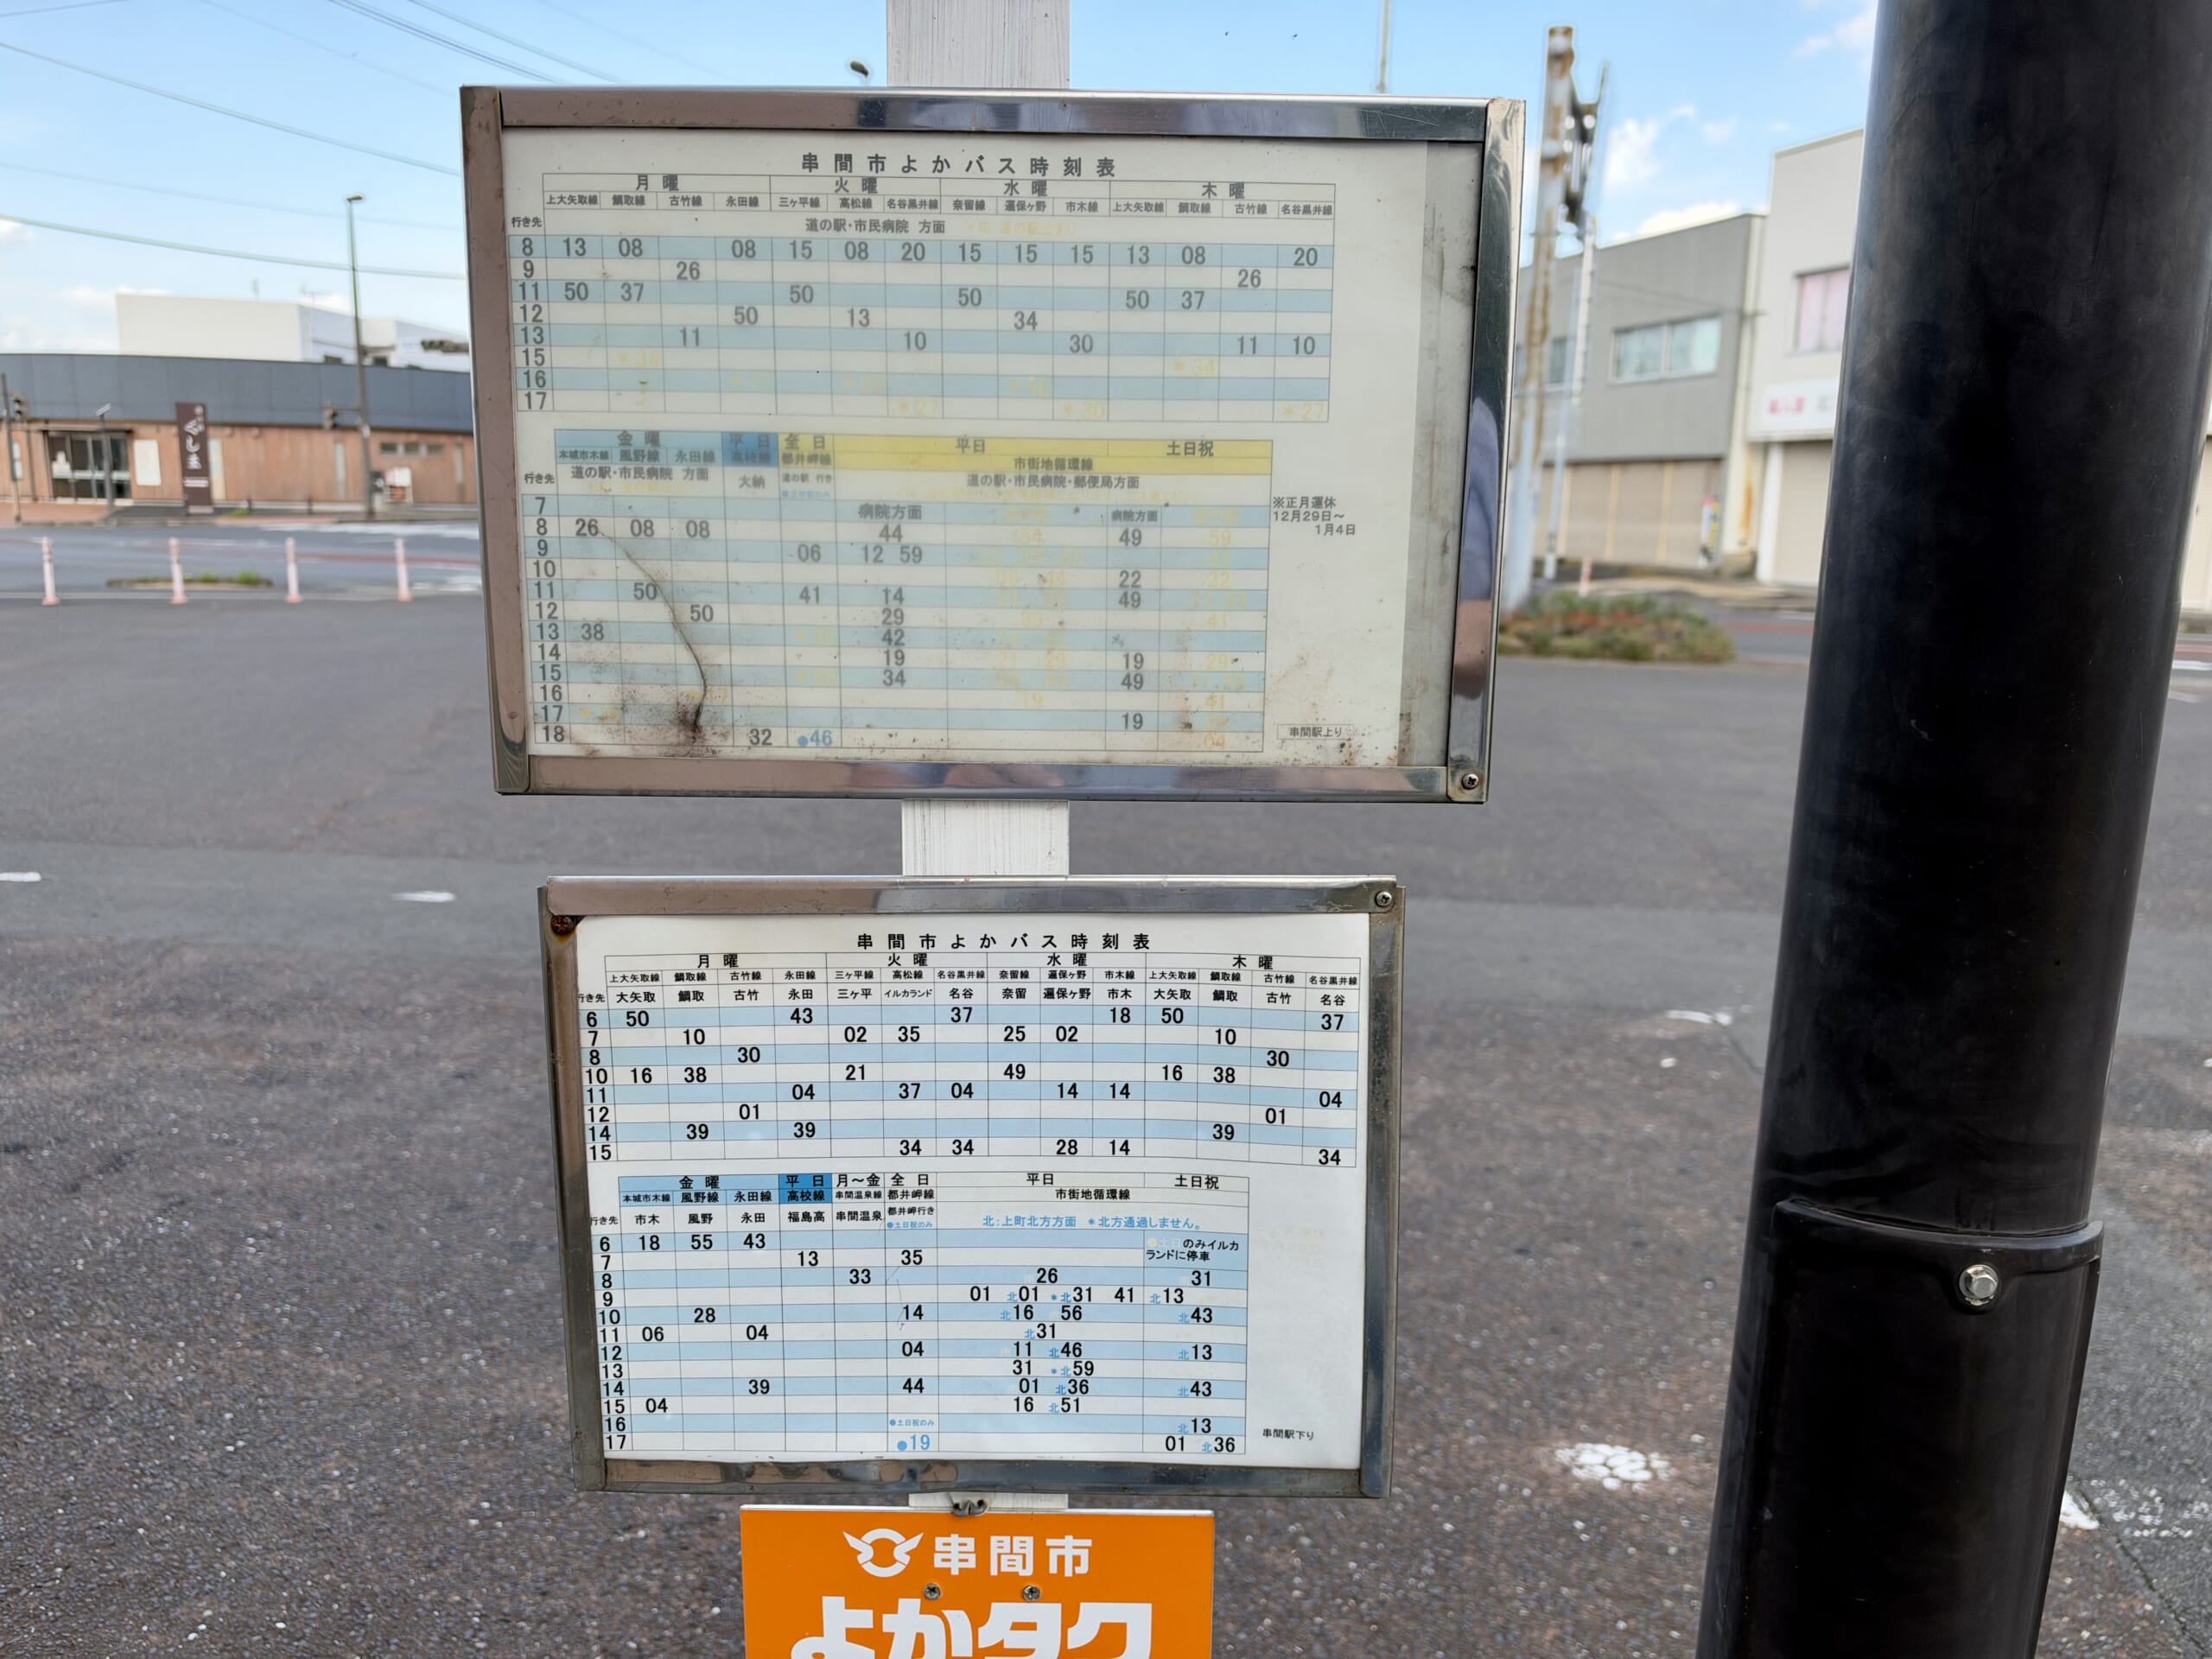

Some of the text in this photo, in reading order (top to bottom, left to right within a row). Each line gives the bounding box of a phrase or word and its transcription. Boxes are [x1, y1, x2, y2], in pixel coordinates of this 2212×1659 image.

[801, 151, 1115, 177] 串間市よかバス時刻表
[636, 175, 678, 192] 月曜
[835, 177, 878, 194] 火曜
[1002, 180, 1048, 197] 水曜
[1202, 182, 1245, 200] 木曜
[545, 194, 598, 207] 上大矢取線
[670, 195, 702, 207] 古竹線
[727, 196, 759, 207] 永田線
[779, 195, 821, 208] 三ヶ平線
[840, 195, 872, 209] 高松線
[953, 199, 985, 211] 奈留線
[1066, 201, 1097, 213] 市木線
[1113, 201, 1166, 213] 上大矢取線
[1235, 203, 1267, 214] 古竹線
[512, 216, 543, 227] 行き先
[806, 218, 944, 233] 道の駅・市民病院 方面
[523, 238, 1318, 266] 8 13 08 08 15 08 20 15 15 15 13 08 20
[618, 431, 660, 448] 金曜
[784, 434, 825, 451] 全日
[956, 437, 985, 454] 平日
[559, 450, 609, 460] 本城市木線
[1166, 440, 1213, 457] 土日祝
[620, 449, 659, 462] 風野線
[676, 450, 715, 463] 永田線
[1015, 457, 1093, 471] 市街地循環線
[572, 465, 709, 480] 道の駅・市民病院 方面
[1274, 497, 1336, 510] ※正月運休
[858, 503, 921, 519] 病院方面
[1112, 510, 1157, 522] 病院方面
[1316, 523, 1355, 536] 1月4日
[1289, 725, 1344, 739] 串間駅上り
[858, 933, 1149, 950] 串間市よかバス時刻表
[698, 954, 740, 968] 月曜
[887, 952, 928, 966] 火曜
[1047, 952, 1086, 966] 水曜
[1233, 954, 1273, 969] 木曜
[610, 974, 659, 982] 上大矢取線
[730, 971, 761, 981] 古竹線
[785, 970, 816, 980] 永田線
[836, 970, 874, 979] 三ヶ平線
[893, 970, 923, 979] 高松線
[1000, 970, 1029, 979] 奈留線
[1105, 970, 1135, 979] 市木線
[1147, 971, 1196, 982] 上大矢取線
[1264, 974, 1294, 983] 古竹線
[617, 992, 655, 1002] 大矢取
[734, 989, 759, 1001] 古竹
[788, 988, 812, 1000] 永田
[837, 988, 872, 999] 三ヶ平
[950, 988, 973, 999] 名谷
[1002, 988, 1026, 999] 奈留
[1108, 988, 1132, 999] 市木
[1154, 988, 1191, 1000] 大矢取
[1267, 992, 1291, 1004] 古竹
[1321, 995, 1344, 1006] 名谷
[626, 1007, 1344, 1030] 50 43 37 18 50 37
[683, 1026, 1236, 1045] 10 02 35 25 02 10
[738, 1047, 1289, 1066] 30 30
[631, 1064, 1235, 1083] 16 38 21 49 16 38
[679, 1175, 719, 1191] 金曜
[785, 1175, 823, 1189] 平日
[891, 1173, 928, 1186] 全日
[1027, 1173, 1053, 1185] 平日
[1175, 1174, 1220, 1189] 土日祝
[681, 1190, 719, 1203] 風野線
[734, 1191, 772, 1202] 永田線
[787, 1190, 824, 1201] 高校線
[836, 1189, 883, 1201] 串間温泉線
[887, 1189, 934, 1199] 都井岬線
[1056, 1189, 1130, 1200] 市街地循環線
[635, 1214, 659, 1225] 市木
[689, 1213, 713, 1224] 風野
[741, 1212, 765, 1224] 永田
[788, 1211, 824, 1223] 福島高
[836, 1211, 883, 1221] 串間温泉
[639, 1234, 765, 1250] 18 55 43
[798, 1250, 922, 1266] 13 35
[1147, 1249, 1211, 1262] ランドに停車
[850, 1268, 1210, 1286] 33 26 31
[695, 1305, 924, 1323] 28 14
[642, 1325, 768, 1341] 06 04
[749, 1378, 924, 1395] 39 44
[646, 1398, 668, 1413] 04
[1263, 1428, 1313, 1440] 串間駅下り
[935, 1533, 1092, 1577] 串間市
